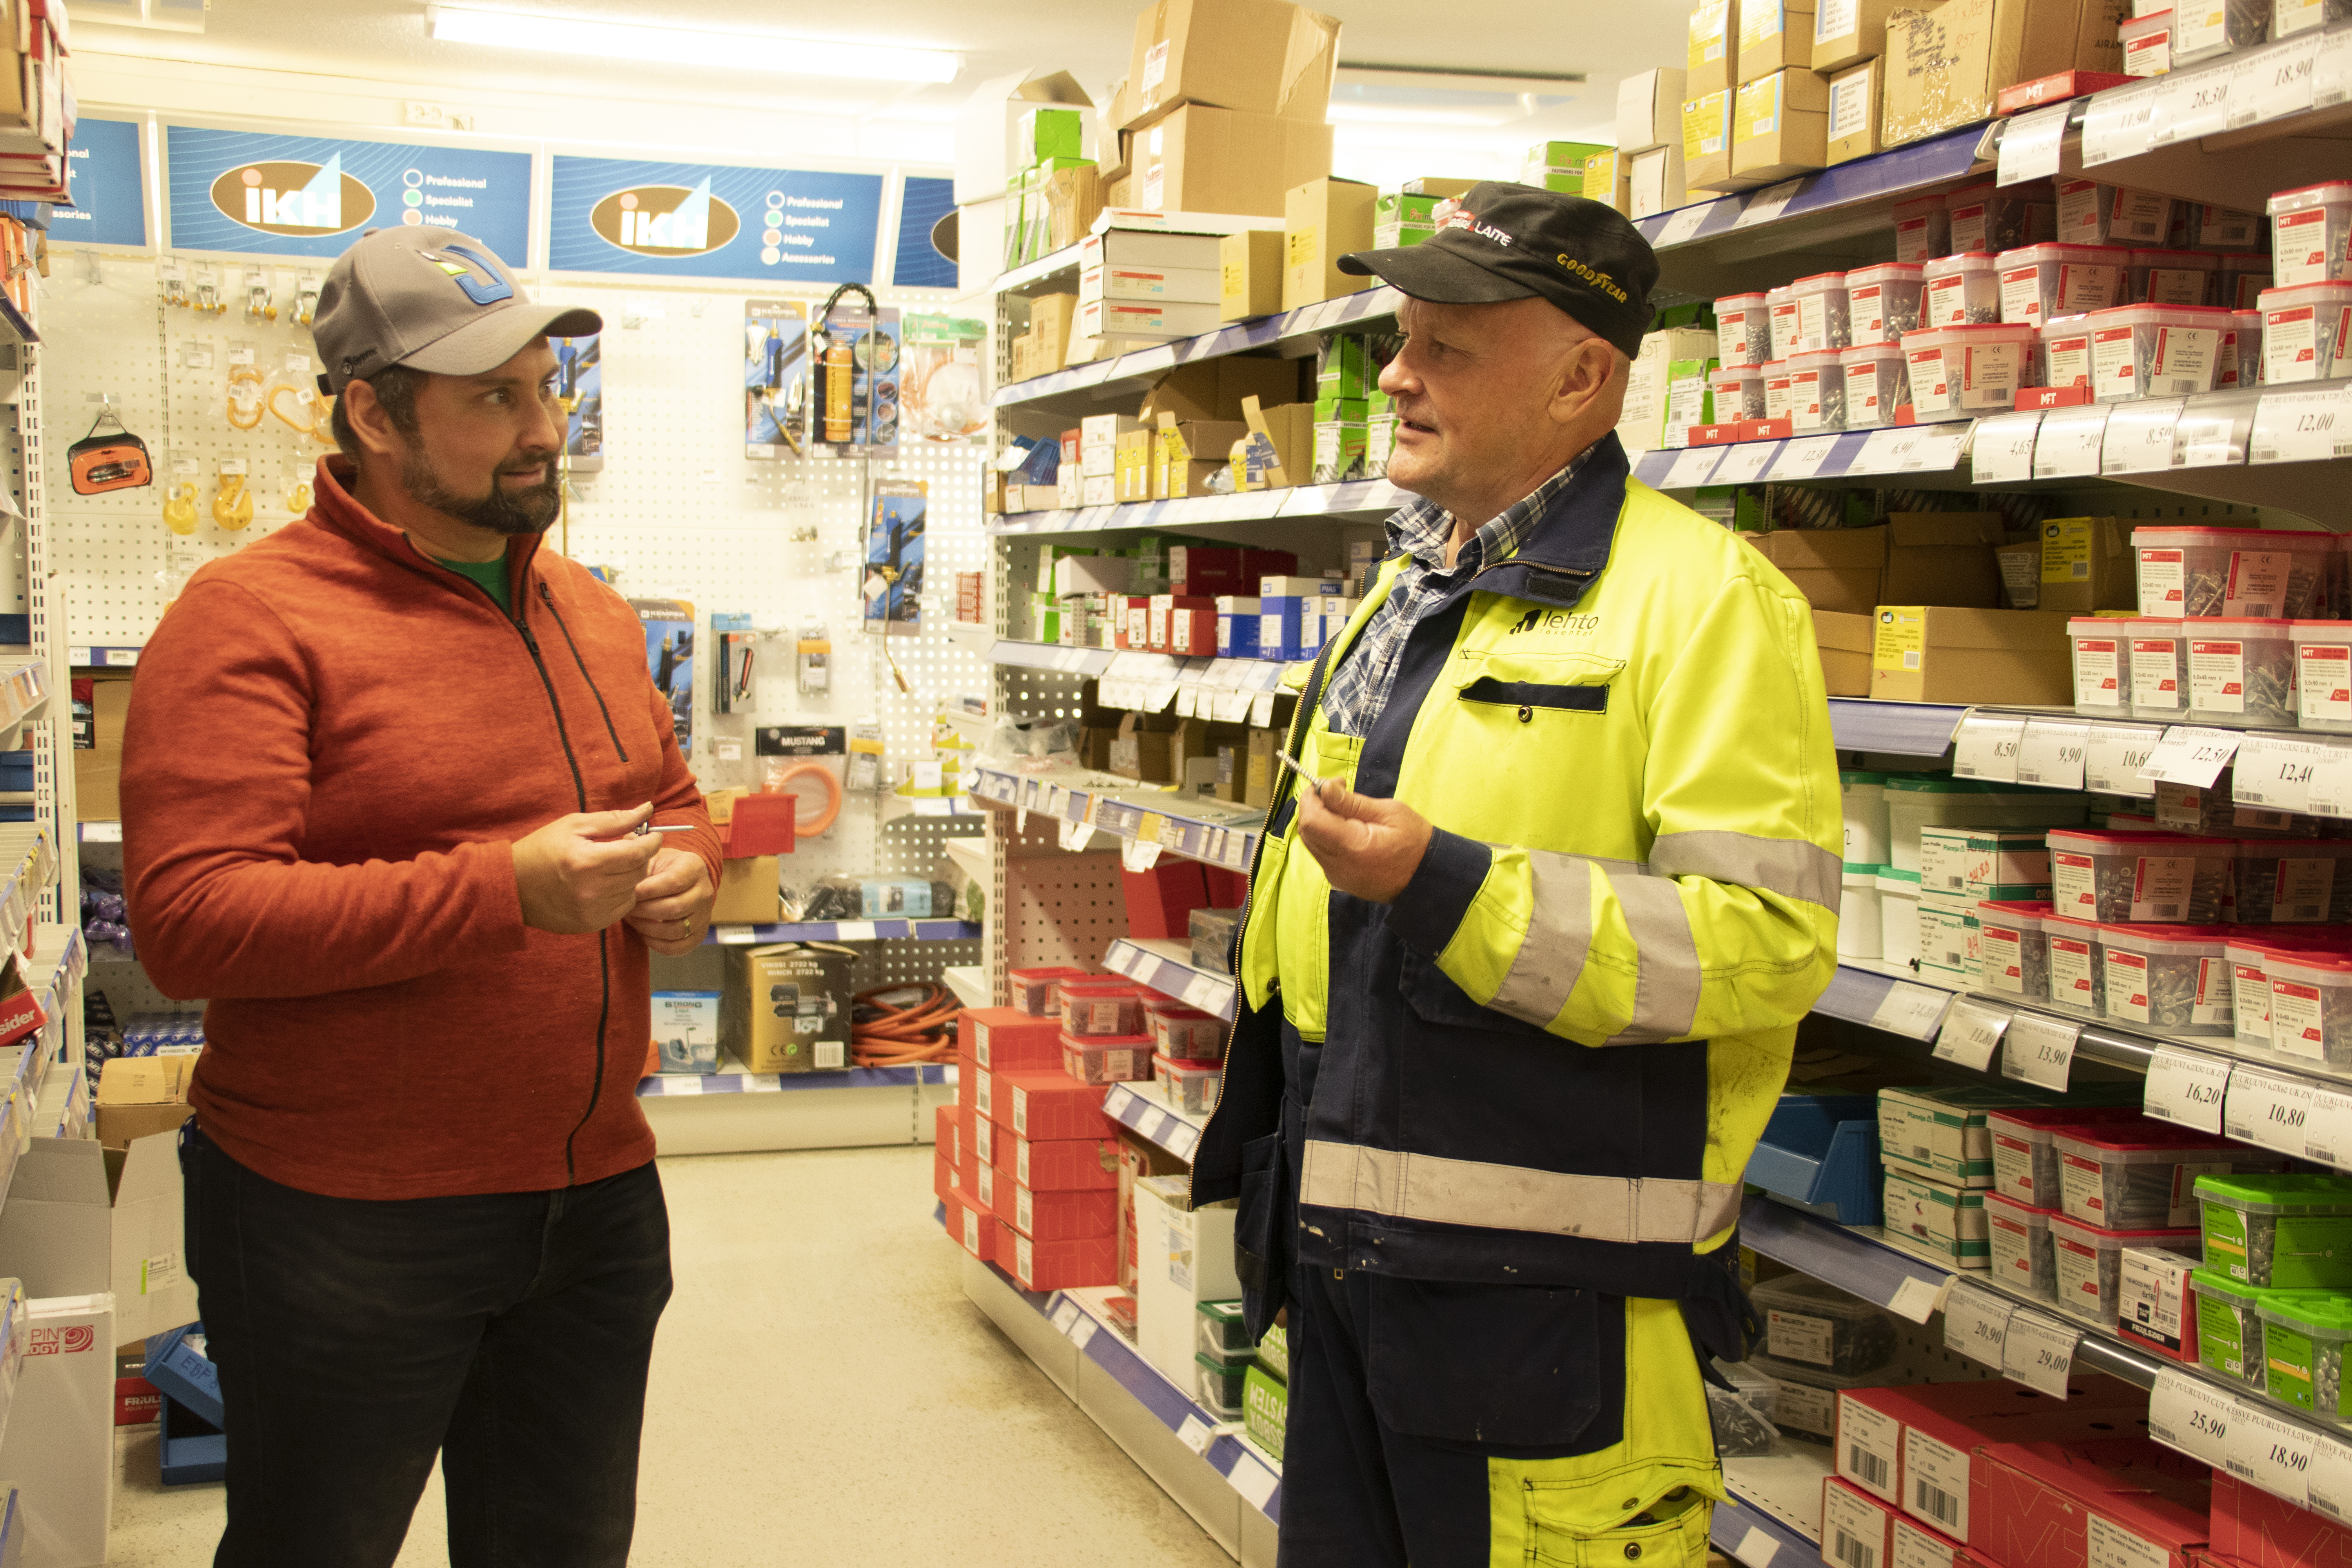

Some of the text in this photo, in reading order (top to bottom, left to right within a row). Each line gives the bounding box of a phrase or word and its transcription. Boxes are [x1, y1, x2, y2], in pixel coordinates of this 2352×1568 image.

[2274, 58, 2313, 86] 18,90
[2026, 84, 2044, 99] MFT
[426, 174, 486, 188] Professional
[426, 195, 473, 208] Specialist
[787, 196, 843, 210] Professional
[426, 214, 458, 228] Hobby
[785, 215, 829, 228] Specialist
[2279, 217, 2291, 226] MFT
[784, 234, 814, 247] Hobby
[1475, 221, 1512, 247] LAITE
[782, 252, 835, 265] Accessories
[1557, 253, 1628, 305] GOODYEAR
[2270, 314, 2280, 323] MFT
[2041, 393, 2056, 405] MFT
[1758, 425, 1771, 436] MFT
[2297, 413, 2334, 432] 12,00
[1706, 429, 1718, 439] MFT
[2146, 426, 2172, 446] 8,50
[2010, 439, 2032, 457] 4,65
[2077, 433, 2100, 452] 7,40
[1543, 610, 1599, 630] lehto
[1540, 628, 1593, 637] rakentaa
[782, 736, 826, 747] MUSTANG
[1994, 741, 2017, 757] 8,50
[2241, 738, 2279, 750] PUURUUVI
[2059, 746, 2082, 763] 9,90
[2190, 746, 2230, 762] 12,50
[2319, 749, 2352, 760] PUURUU
[1943, 844, 1960, 852] Plannja
[1941, 920, 1956, 929] Plannja
[2237, 968, 2248, 976] MFT
[2274, 984, 2285, 992] MFT
[1969, 1027, 1997, 1046] 11,80
[2038, 1045, 2067, 1065] 13,90
[2153, 1055, 2186, 1069] PUURUUVI
[2206, 1068, 2216, 1076] UK
[2231, 1073, 2267, 1089] PUURUUVI
[2288, 1087, 2299, 1096] UK
[2185, 1082, 2221, 1105] 16,20
[2314, 1093, 2352, 1109] PUURUUV
[2268, 1103, 2305, 1127] 10,80
[1975, 1320, 2002, 1344] 20,90
[2037, 1349, 2068, 1372] 29,00
[2157, 1372, 2225, 1411] ESSVE PUURUUVI CUT
[2270, 1386, 2282, 1396] ESSVE
[2190, 1410, 2226, 1439] 25,90
[2231, 1407, 2313, 1444] ESSVE PUURUUVI 5,0X90
[2317, 1437, 2337, 1455] ESSVE
[2269, 1444, 2308, 1472] 18,90
[2117, 1555, 2127, 1567] ESK
